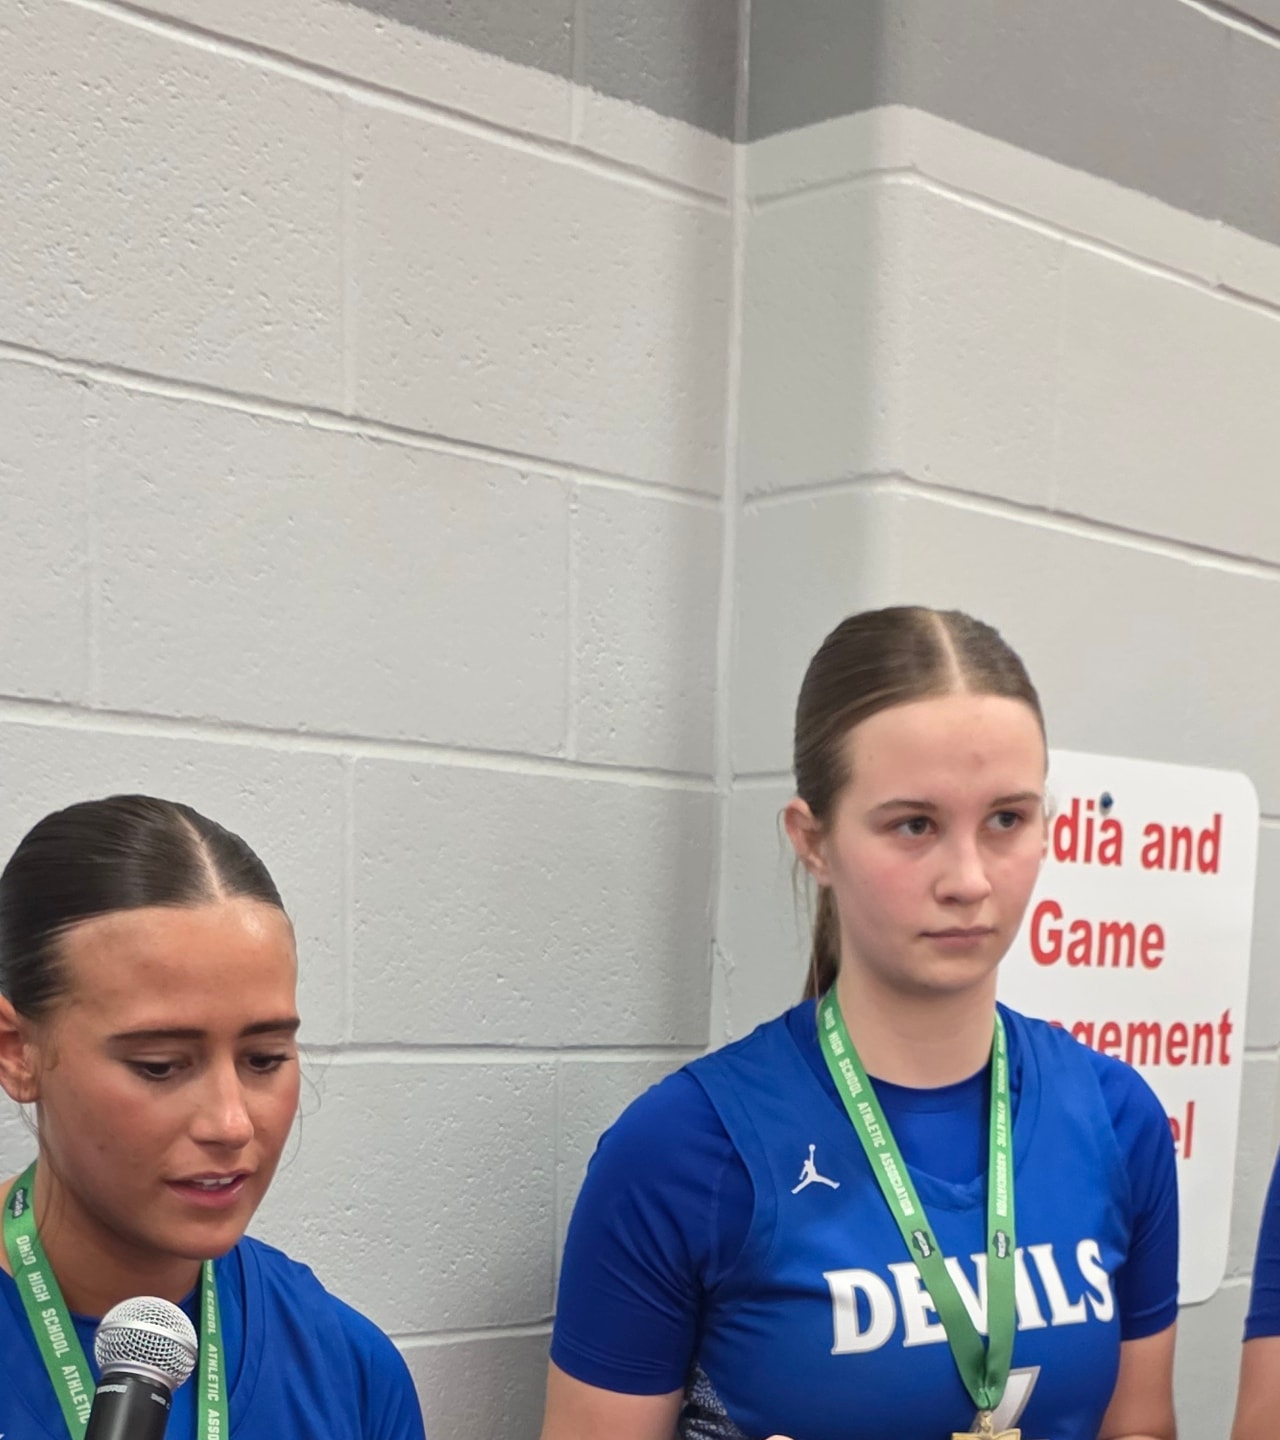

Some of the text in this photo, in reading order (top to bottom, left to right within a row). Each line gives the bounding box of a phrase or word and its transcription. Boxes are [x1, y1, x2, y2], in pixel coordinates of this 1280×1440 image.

[1053, 797, 1224, 875] dia and
[1029, 899, 1166, 970] Game
[838, 1057, 864, 1099] SCHOOL
[856, 1101, 887, 1149] ATHLETIC
[878, 1152, 917, 1218] ASSOCIATION
[15, 1234, 37, 1266] OHIO
[27, 1270, 51, 1303] HIGH
[41, 1309, 72, 1359] SCHOOL
[822, 1238, 1116, 1356] DEVILS
[207, 1343, 220, 1402] ATHLETIC
